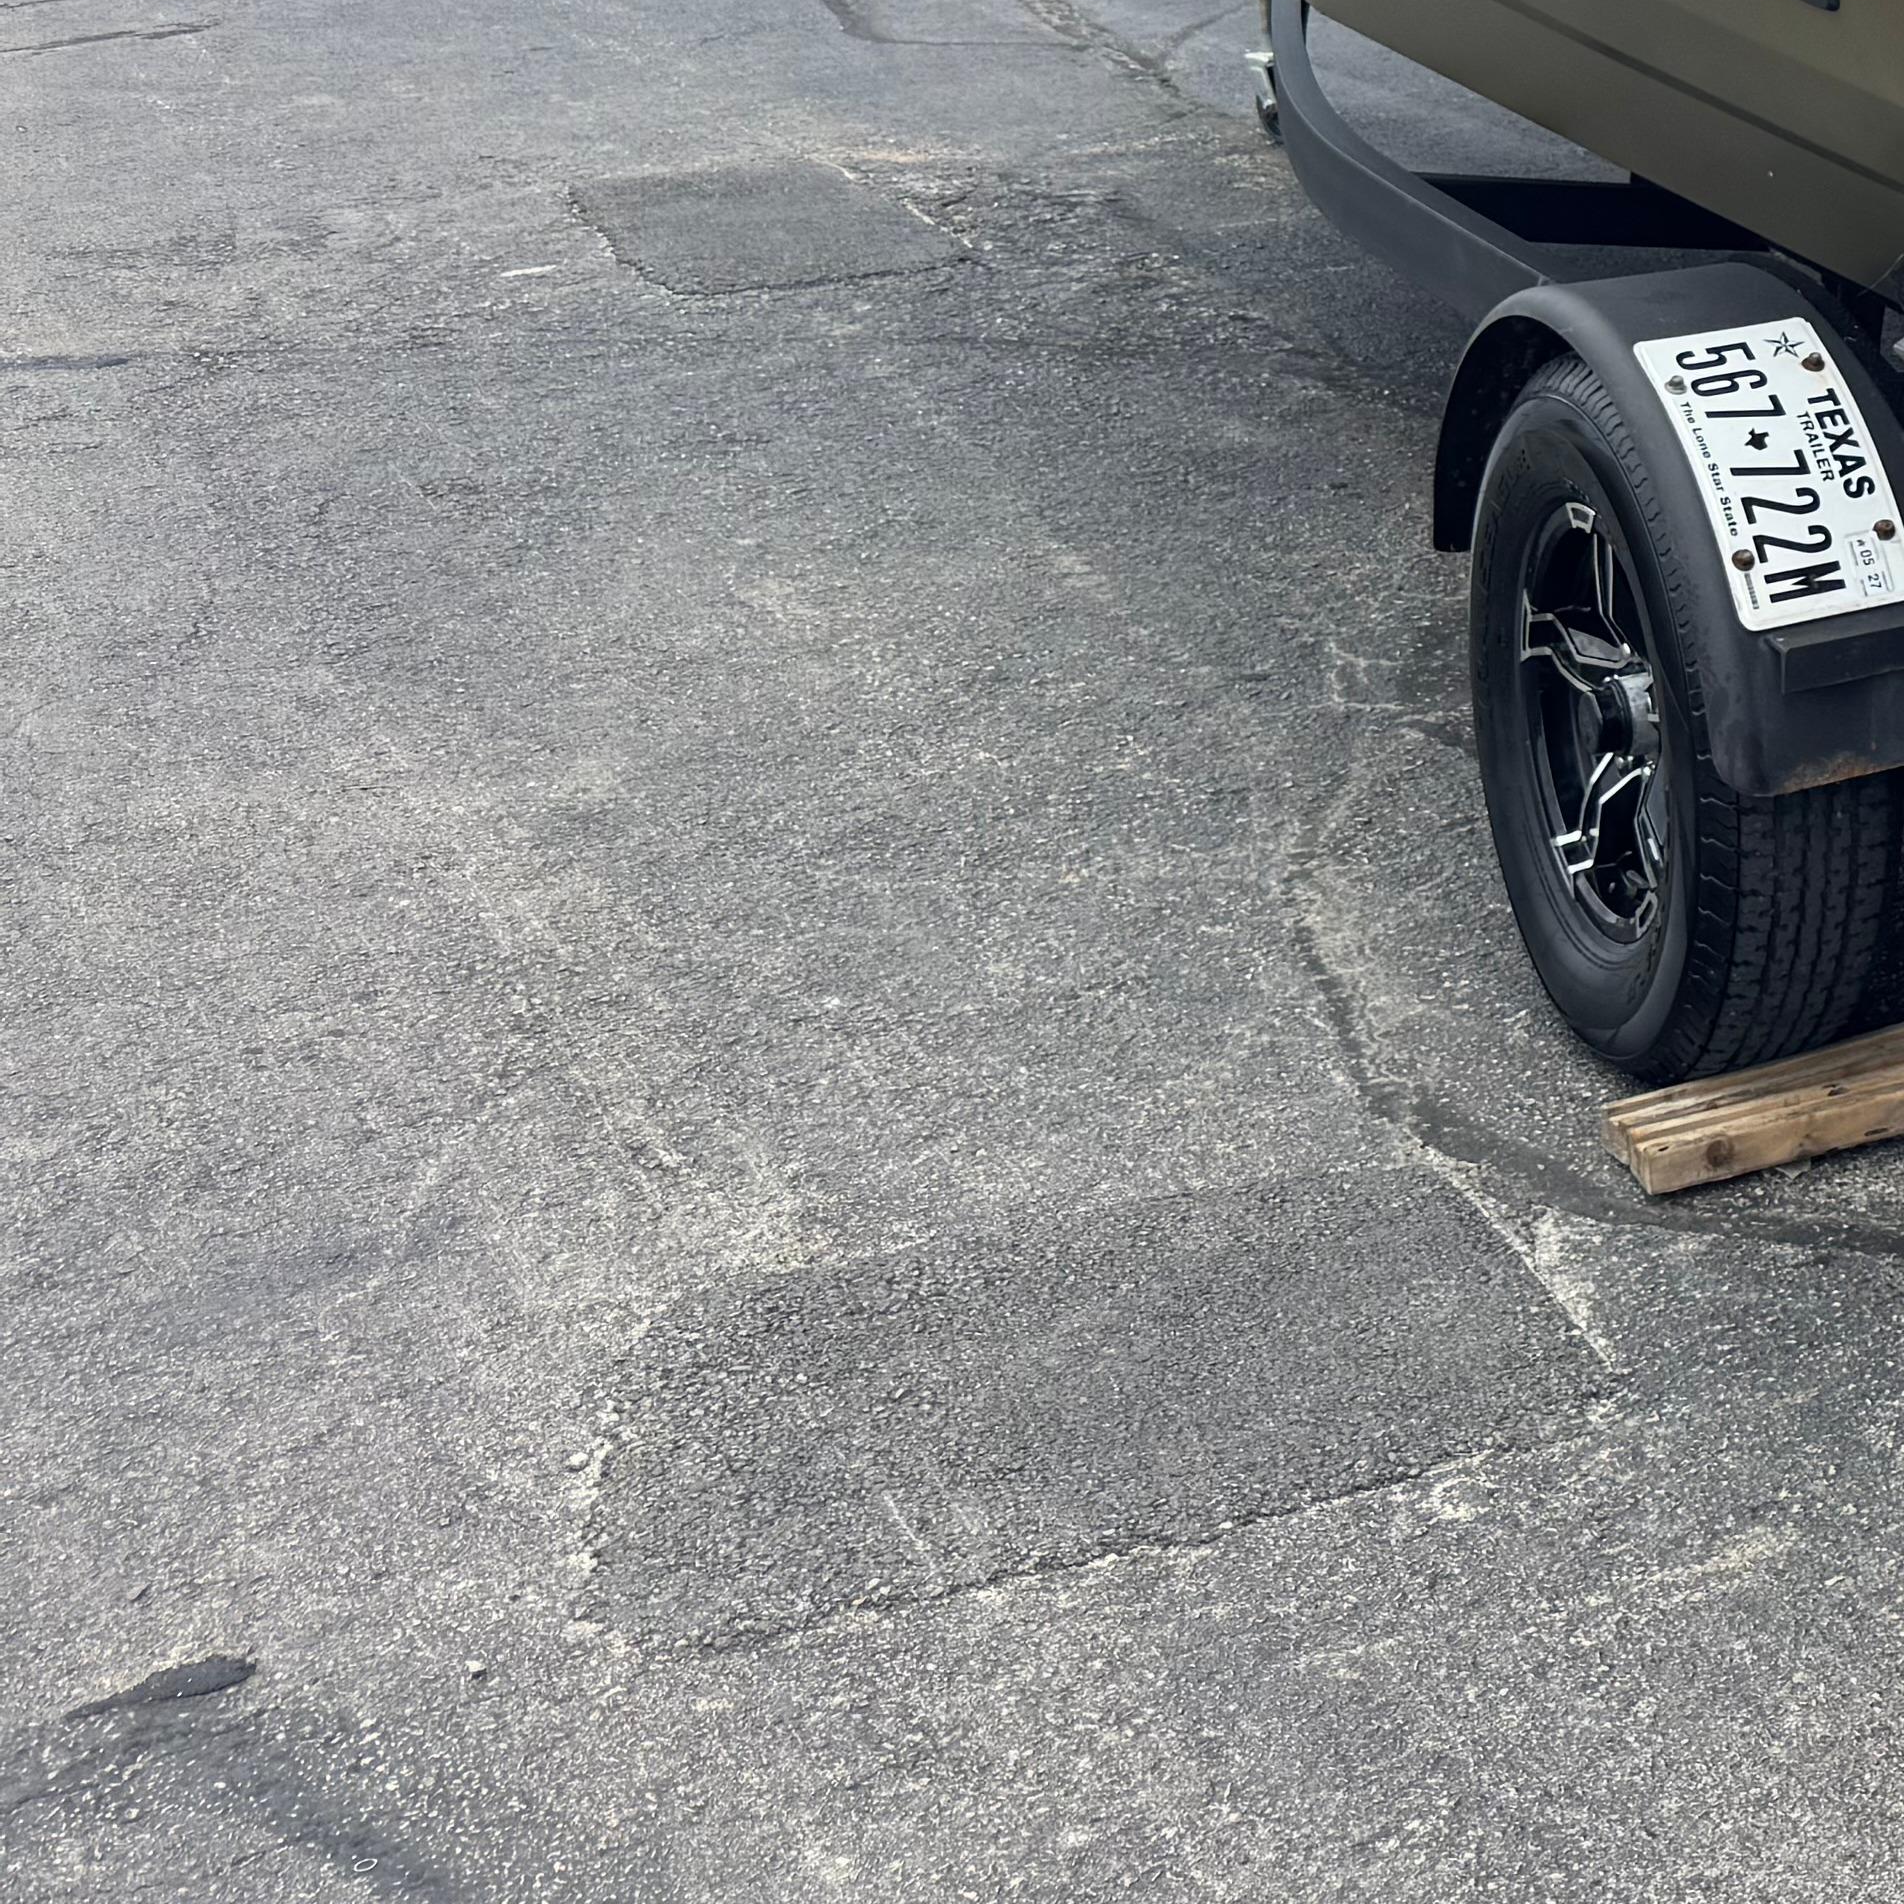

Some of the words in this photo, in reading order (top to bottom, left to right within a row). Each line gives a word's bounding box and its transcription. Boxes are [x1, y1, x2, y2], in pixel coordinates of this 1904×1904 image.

[1675, 340, 1787, 419] 567
[1680, 401, 1696, 424] The
[1692, 427, 1711, 459] Lone
[1708, 462, 1725, 493] Star
[1720, 496, 1739, 538] State
[1796, 410, 1835, 482] TRAILER
[1807, 387, 1877, 500] TEXAS
[1729, 448, 1847, 604] 722M
[1860, 549, 1876, 566] 05
[1867, 573, 1883, 588] 27
